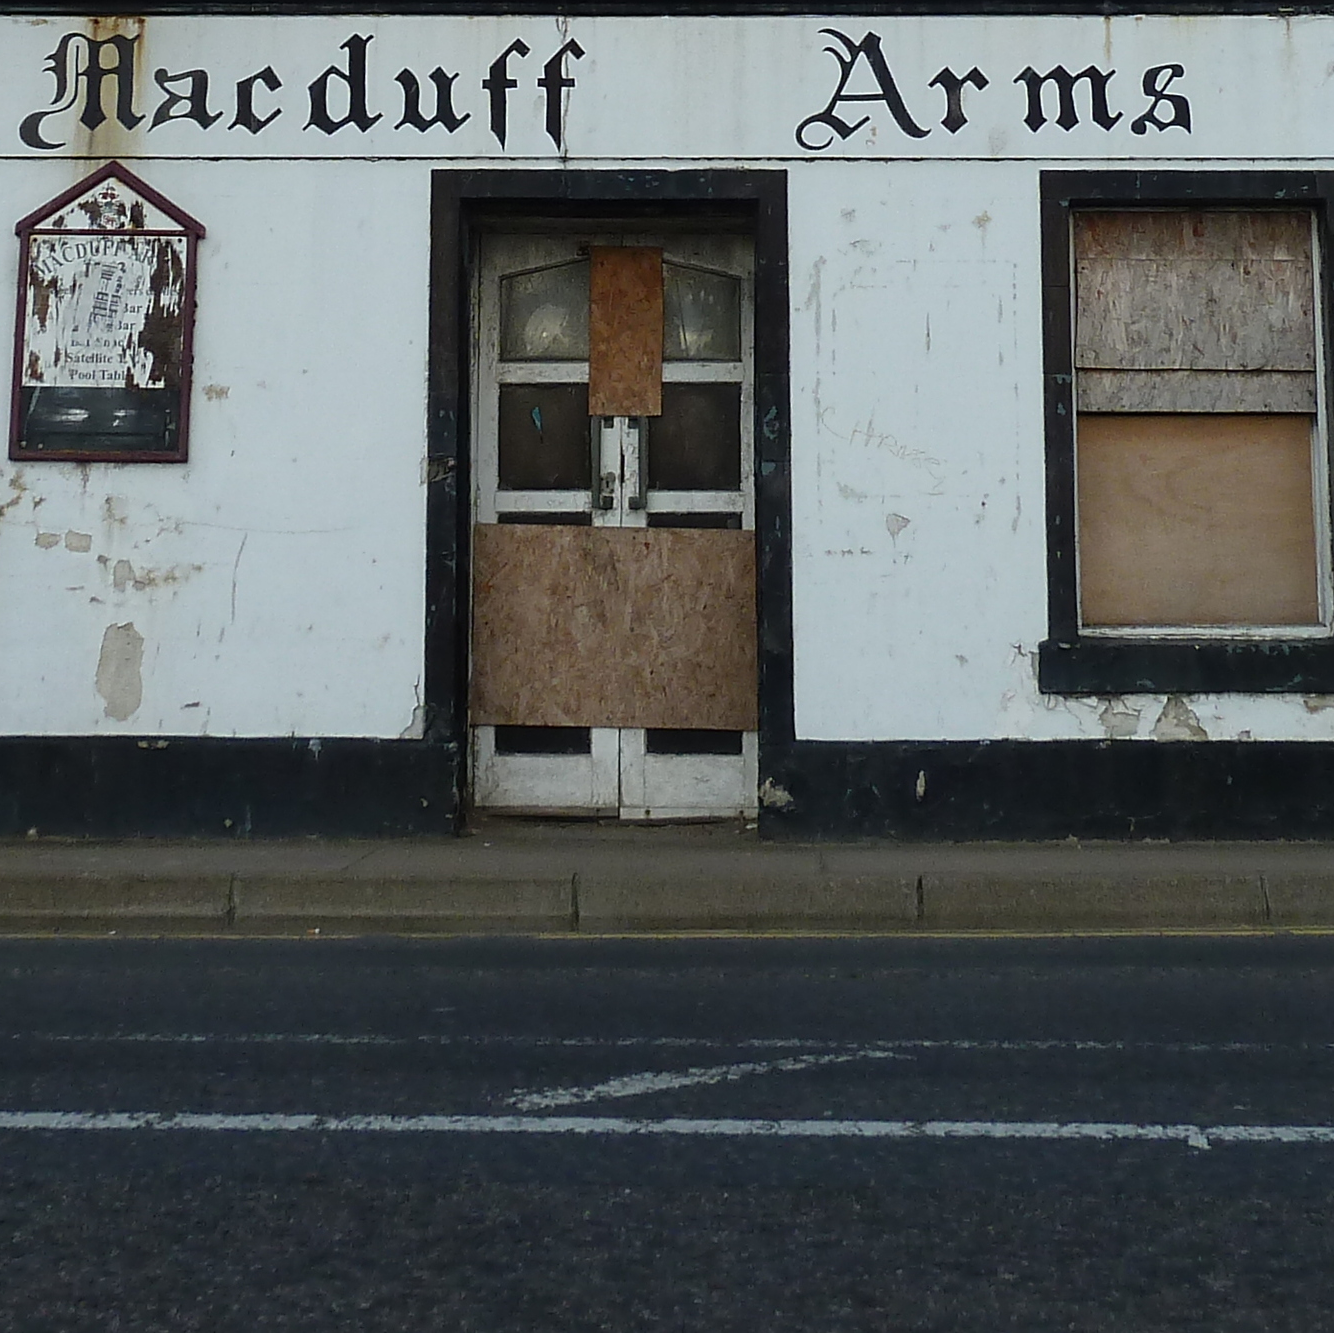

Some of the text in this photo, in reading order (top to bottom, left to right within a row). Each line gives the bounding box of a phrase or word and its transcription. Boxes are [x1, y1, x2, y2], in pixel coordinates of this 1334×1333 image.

[19, 28, 1194, 153] Macduff Arms
[66, 352, 113, 364] Satellite
[68, 368, 130, 381] Pool Tabl
